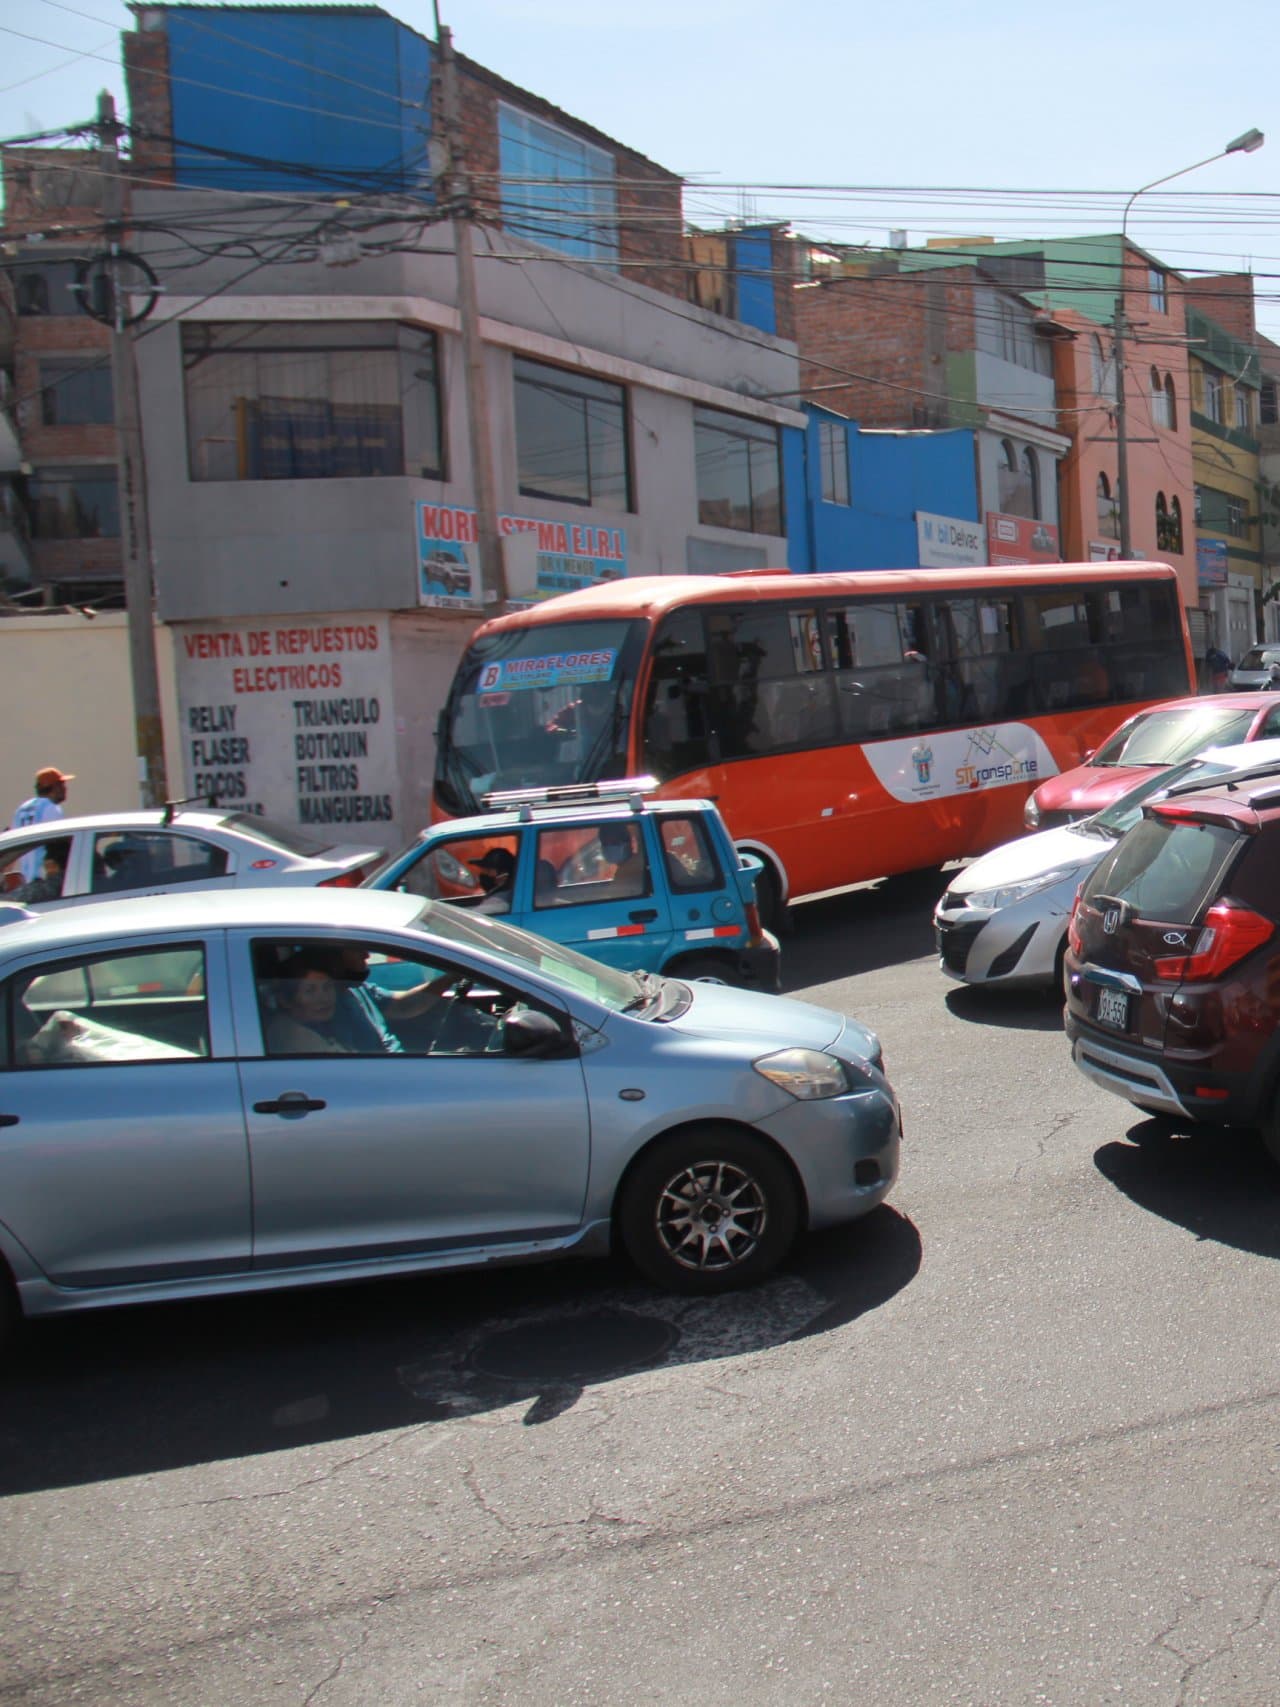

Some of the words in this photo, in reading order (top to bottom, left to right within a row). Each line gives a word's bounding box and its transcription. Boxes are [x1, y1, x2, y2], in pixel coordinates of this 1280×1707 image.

[950, 525, 979, 550] Delvac
[184, 632, 244, 659] VENTA
[247, 630, 272, 656] DE
[276, 625, 379, 654] REPUESTOS
[507, 650, 612, 673] MIRAFLORES
[233, 663, 342, 693] ELECTRICOS
[483, 665, 500, 688] B
[189, 704, 237, 733] RELAY
[293, 698, 380, 726] TRIANGULO
[192, 737, 250, 766] FLASER
[295, 731, 368, 760] BOTIQUIN
[194, 772, 247, 798] FOCOS
[297, 764, 358, 792] FILTROS
[299, 795, 392, 824] MANGUERAS
